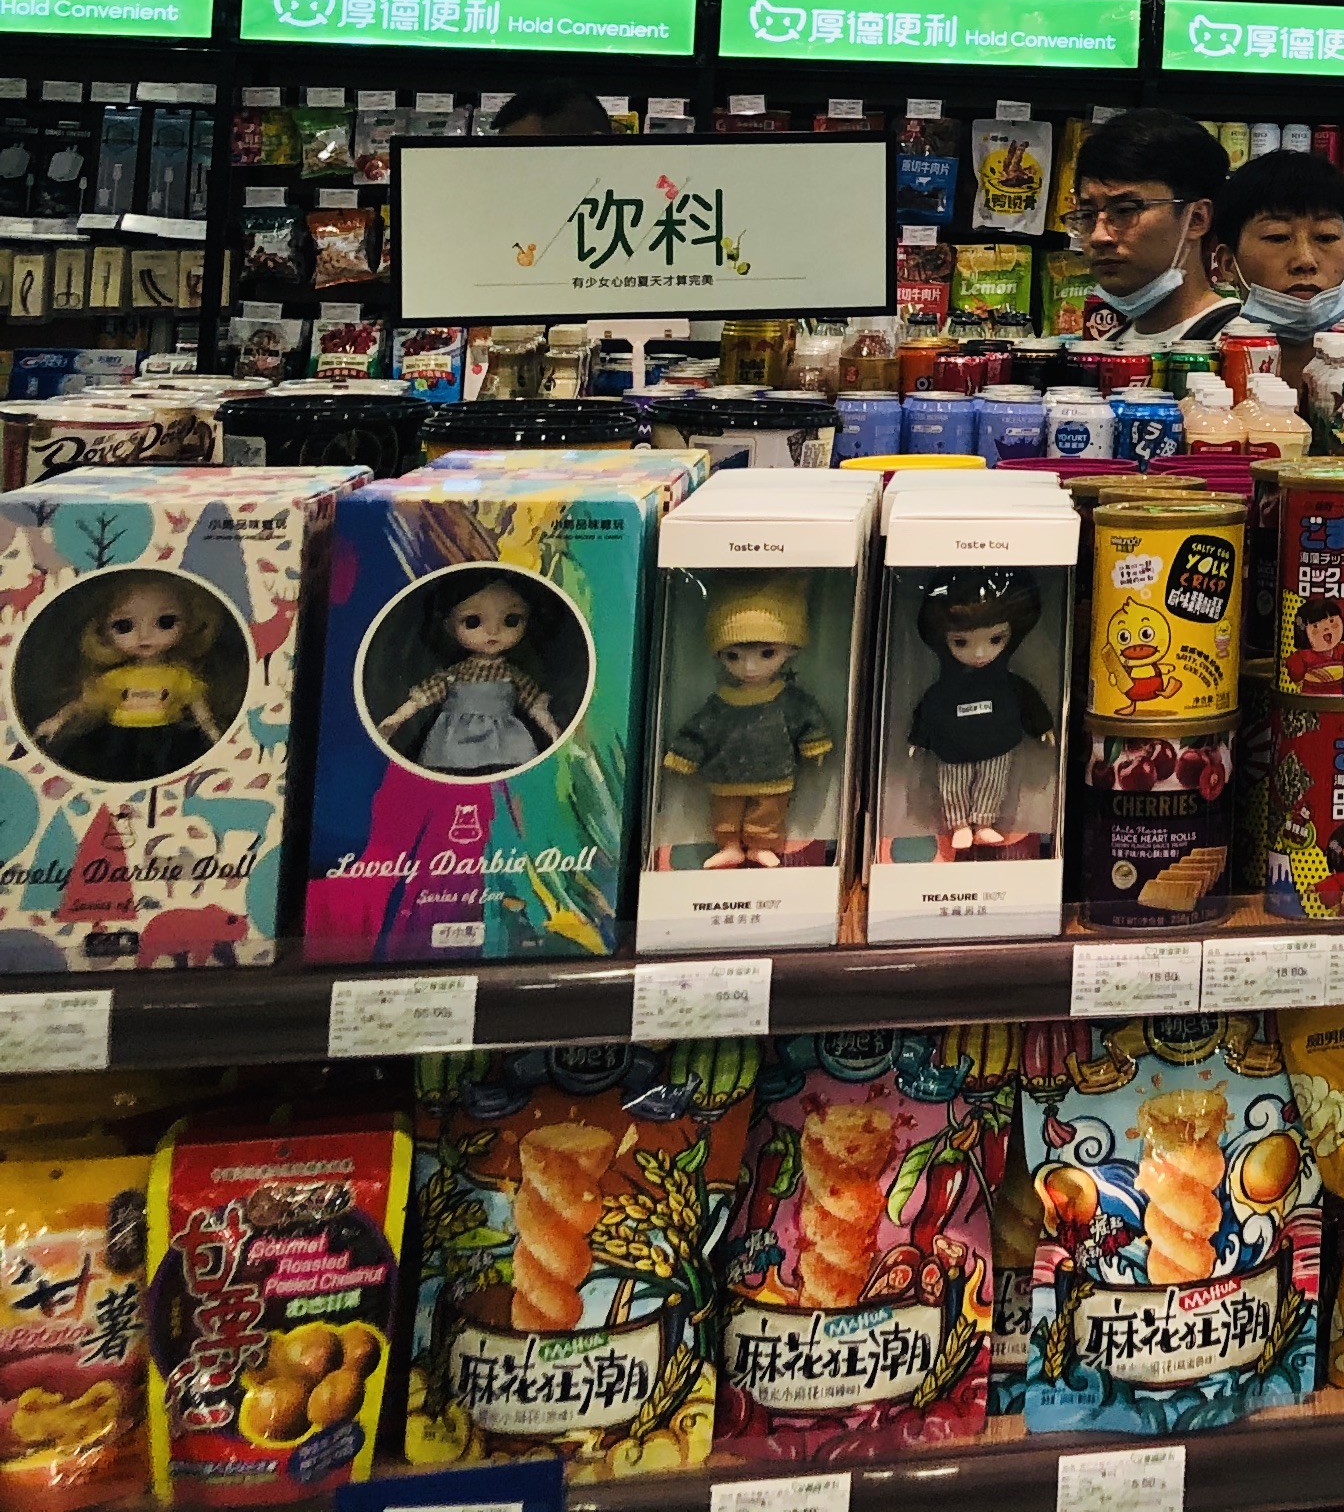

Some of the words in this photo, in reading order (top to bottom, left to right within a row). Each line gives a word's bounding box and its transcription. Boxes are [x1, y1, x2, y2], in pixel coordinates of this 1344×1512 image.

[0, 0, 50, 19] Hold
[54, 0, 179, 22] Convenient
[508, 17, 554, 33] Hold
[557, 19, 670, 41] Convenient
[808, 9, 957, 47] 厚德便利
[965, 31, 1008, 46] Hold
[1010, 31, 1117, 52] Convenient
[566, 187, 725, 270] 饮料
[572, 273, 714, 290] 有少女心的夏天才算完美
[960, 281, 1017, 296] Lemon
[729, 542, 760, 553] Taste
[764, 541, 785, 555] toy
[955, 540, 986, 550] Taste
[989, 539, 1010, 552] toy
[1186, 553, 1230, 578] YOLK
[1298, 567, 1341, 581] ロック
[1179, 571, 1227, 593] CRISP
[1112, 794, 1198, 817] CHERRIES
[1140, 833, 1168, 843] HEART
[1170, 832, 1197, 841] ROLLS
[83, 856, 182, 884] Darbie
[191, 853, 256, 880] Doll
[326, 852, 420, 884] Lovely
[429, 848, 527, 876] Darbie
[534, 846, 597, 873] Doll
[692, 901, 751, 911] TREASURE
[922, 893, 978, 902] TREASURE
[278, 1254, 348, 1273] Roasted
[1084, 1288, 1272, 1368] 麻花狂潮
[733, 1312, 934, 1391] 麻花狂潮
[457, 1336, 650, 1415] 麻花狂潮
